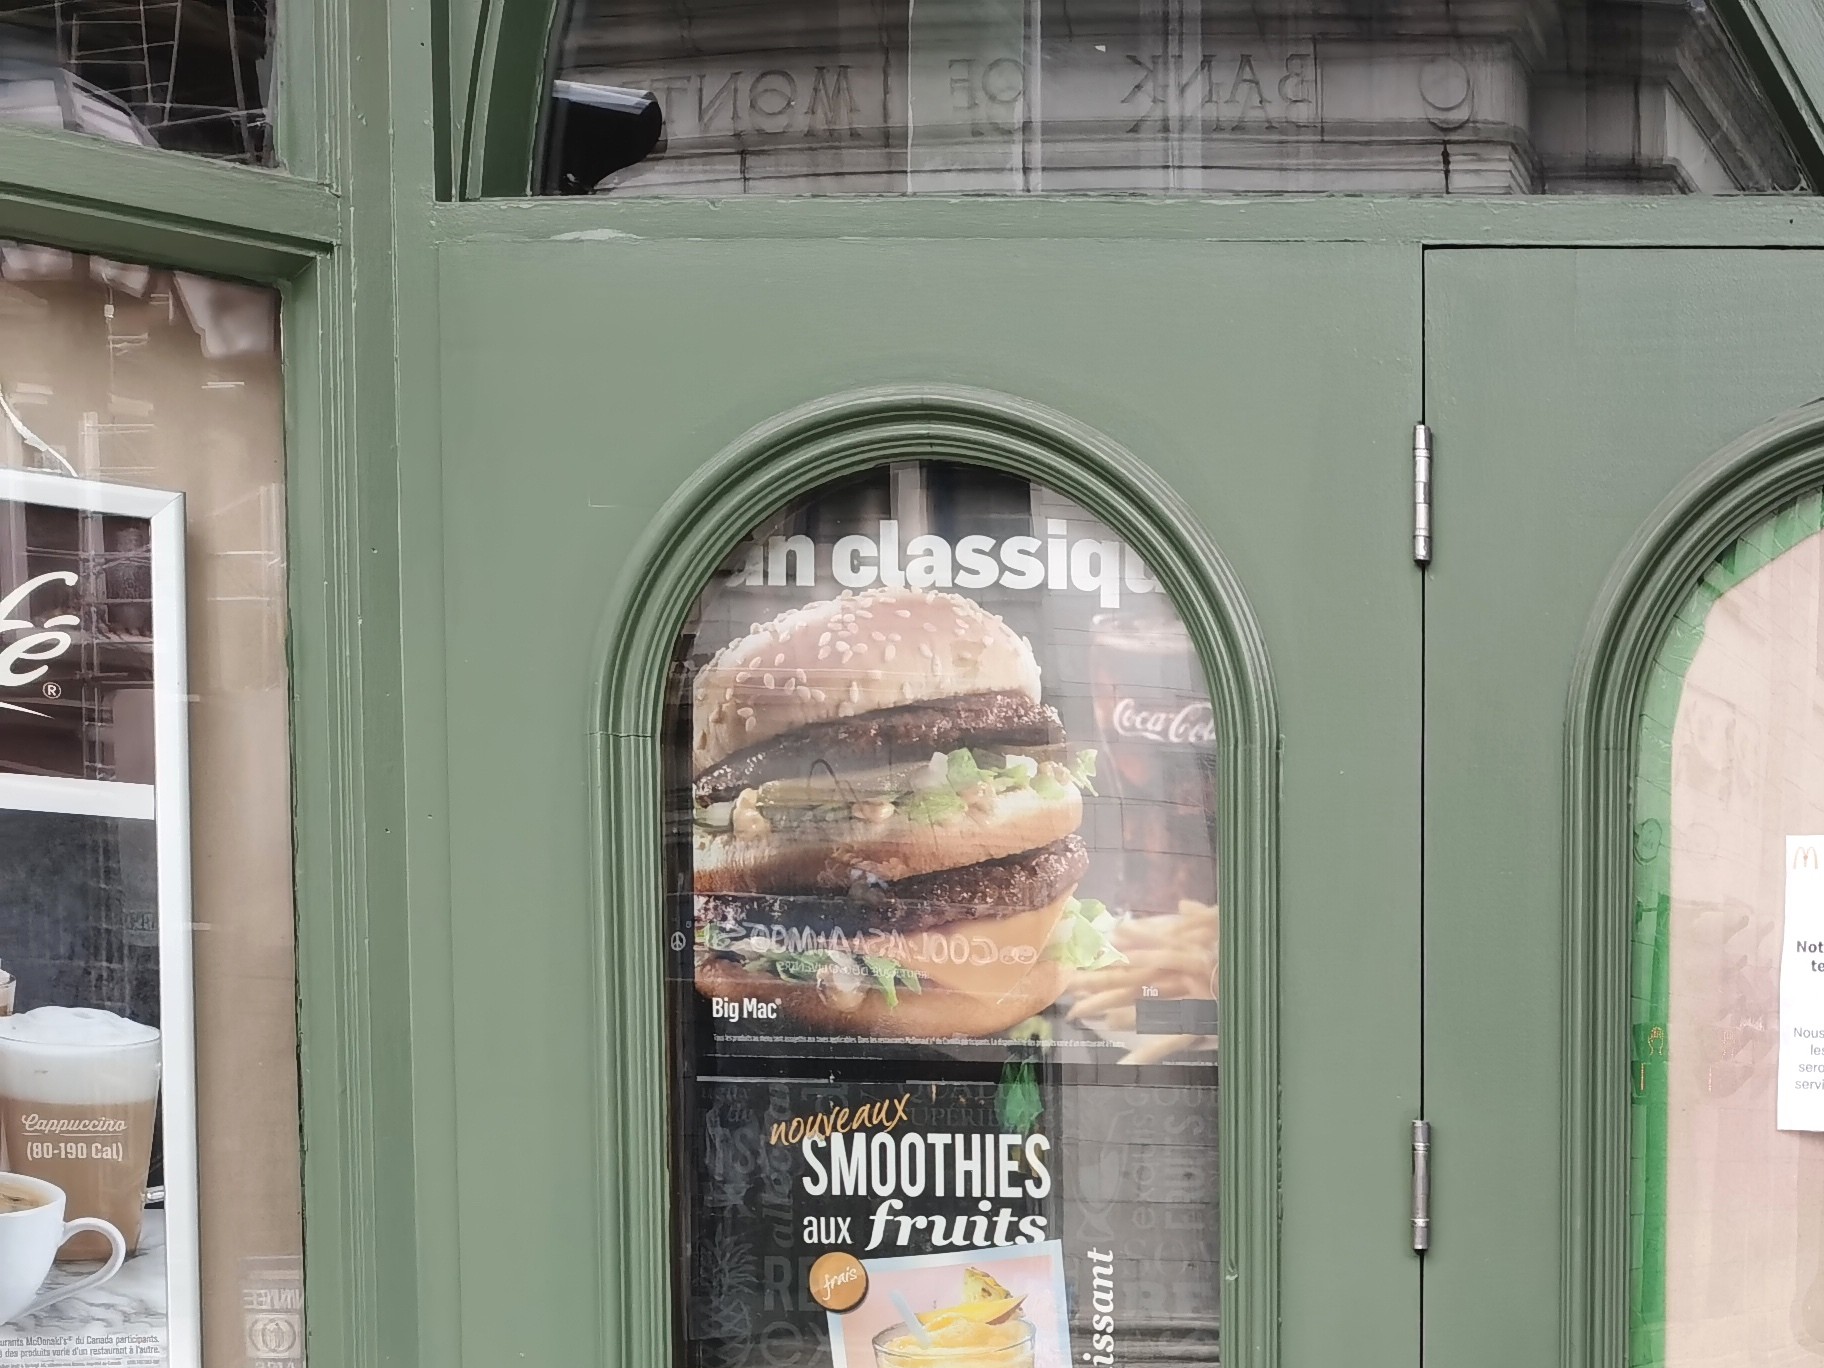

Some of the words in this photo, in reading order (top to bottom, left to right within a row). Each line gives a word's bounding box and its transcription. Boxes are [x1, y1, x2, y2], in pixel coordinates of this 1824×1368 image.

[1142, 985, 1159, 997] Trio
[712, 997, 739, 1022] Big
[21, 1113, 128, 1134] Cappuccino
[769, 1093, 911, 1146] nouveaux
[27, 1142, 87, 1160] (80-190
[91, 1142, 123, 1161] Cal)
[802, 1131, 1051, 1199] SMOOTHIES
[803, 1215, 855, 1244] aux
[864, 1199, 1048, 1251] fruits
[823, 1265, 859, 1301] frais
[20, 1347, 50, 1359] produits
[52, 1347, 70, 1356] varie
[72, 1346, 87, 1355] d'un
[90, 1346, 127, 1355] restaurant
[76, 1336, 85, 1344] du
[86, 1335, 113, 1344] Canada
[115, 1335, 159, 1347] participants.
